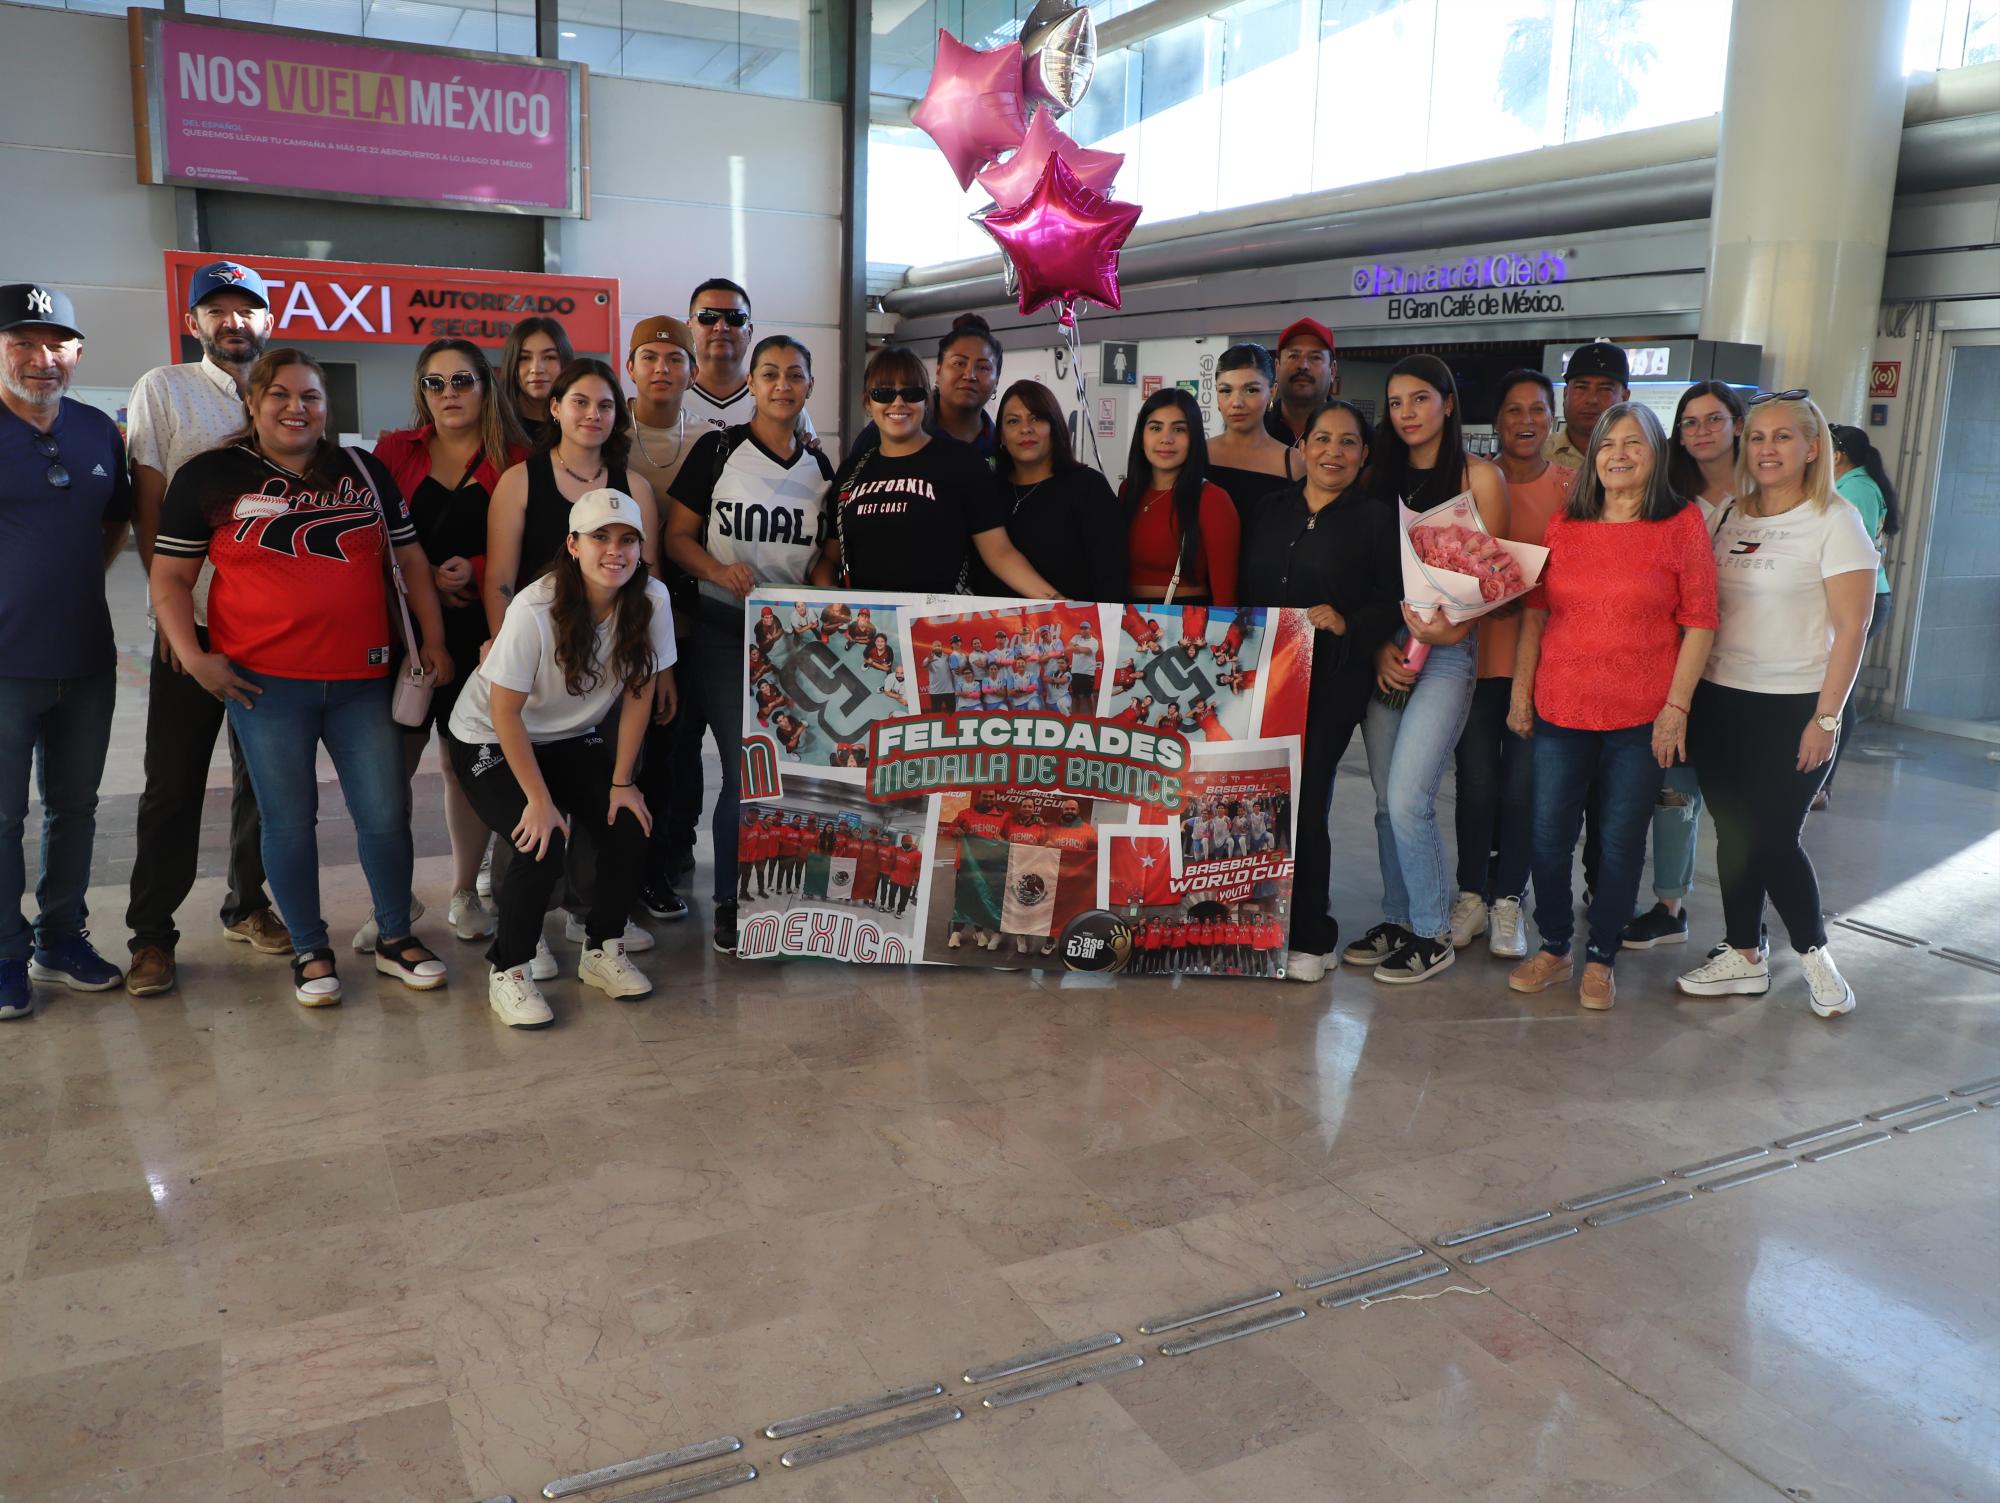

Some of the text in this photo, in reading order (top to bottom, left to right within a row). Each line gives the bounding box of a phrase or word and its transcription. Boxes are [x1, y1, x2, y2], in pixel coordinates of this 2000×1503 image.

[179, 52, 551, 138] NOS VUELA MÉXICO
[182, 119, 200, 127] DEL
[182, 129, 234, 140] QUEREMOS
[236, 134, 268, 144] LLEVAR
[283, 138, 326, 149] CAMPAÑA
[380, 148, 441, 160] AEROPUERTOS
[462, 155, 488, 165] LARGO
[1377, 253, 1556, 295] Punta del Cielo
[27, 288, 53, 314] NY
[408, 289, 576, 315] AUTORIZADO
[1388, 289, 1565, 320] El Gran Café de México.
[408, 317, 512, 339] Y SEGUR
[848, 477, 936, 509] ALIFORNIA
[857, 502, 907, 515] WEST COAST
[1716, 557, 1775, 570] LFIGER
[878, 718, 1183, 770] FELICIDADES
[874, 753, 1183, 808] MEDALLA DE BRONCE
[996, 794, 1042, 806] WORD
[1169, 869, 1250, 894] WORLD
[1220, 883, 1251, 901] YOUTH
